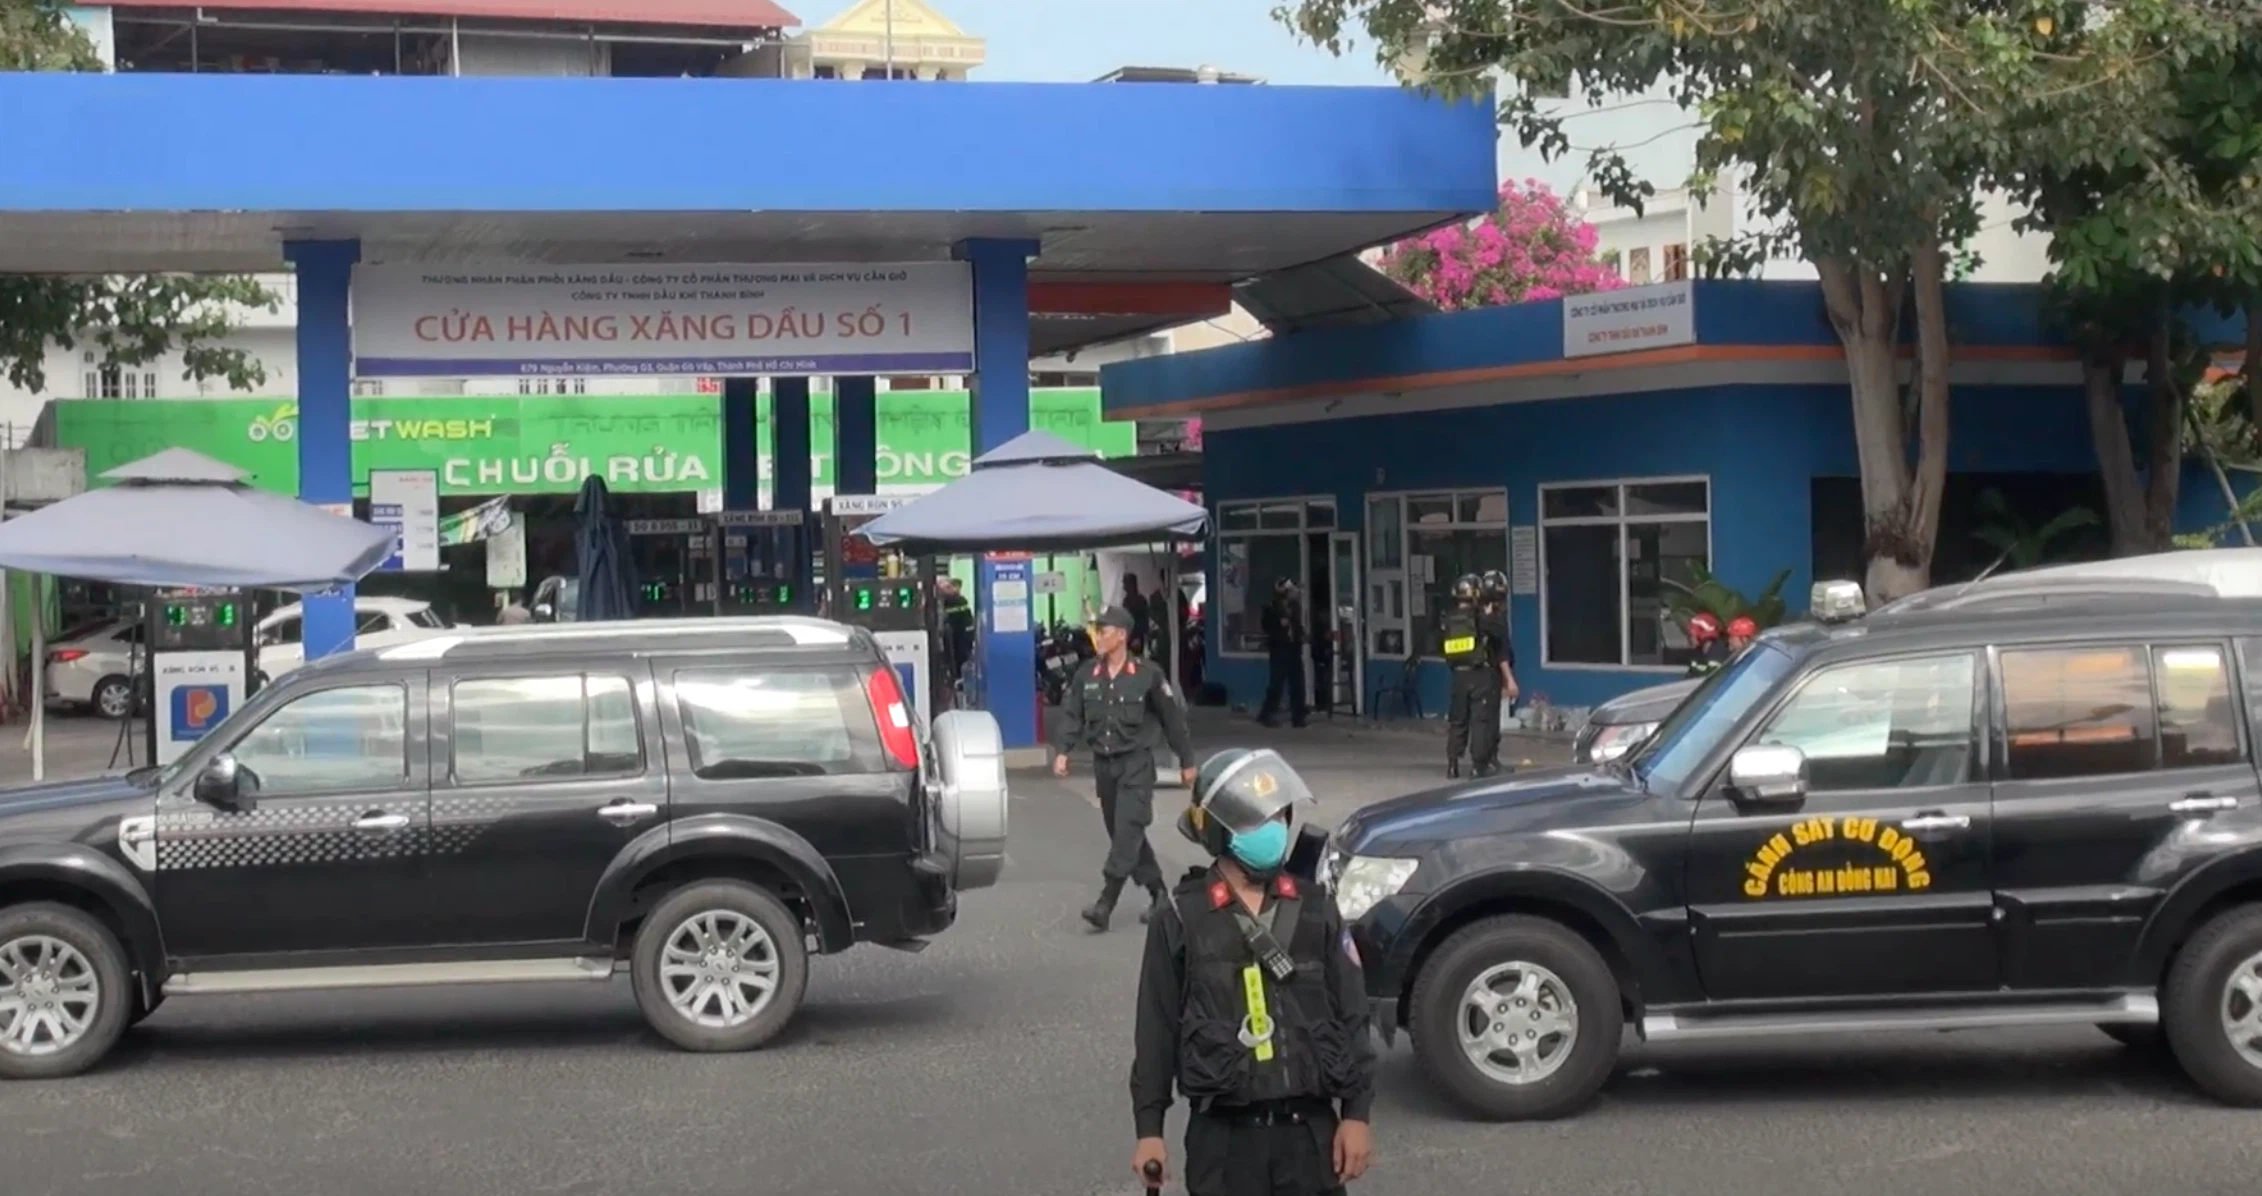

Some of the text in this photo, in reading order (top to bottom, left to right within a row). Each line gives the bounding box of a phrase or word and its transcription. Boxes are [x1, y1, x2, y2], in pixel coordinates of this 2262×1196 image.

[605, 290, 618, 300] TY
[632, 271, 663, 284] CÔNG
[666, 273, 679, 284] TY
[415, 302, 911, 342] CỬA HÀNG XĂNG DẦU SỐ 1
[445, 442, 592, 486] CHUỖI
[608, 446, 709, 484] RỬA
[1744, 833, 1793, 897] CẢNH
[1842, 816, 1879, 843] CƠ
[1778, 860, 1898, 895] CÔNG AN ĐỒNG NAI
